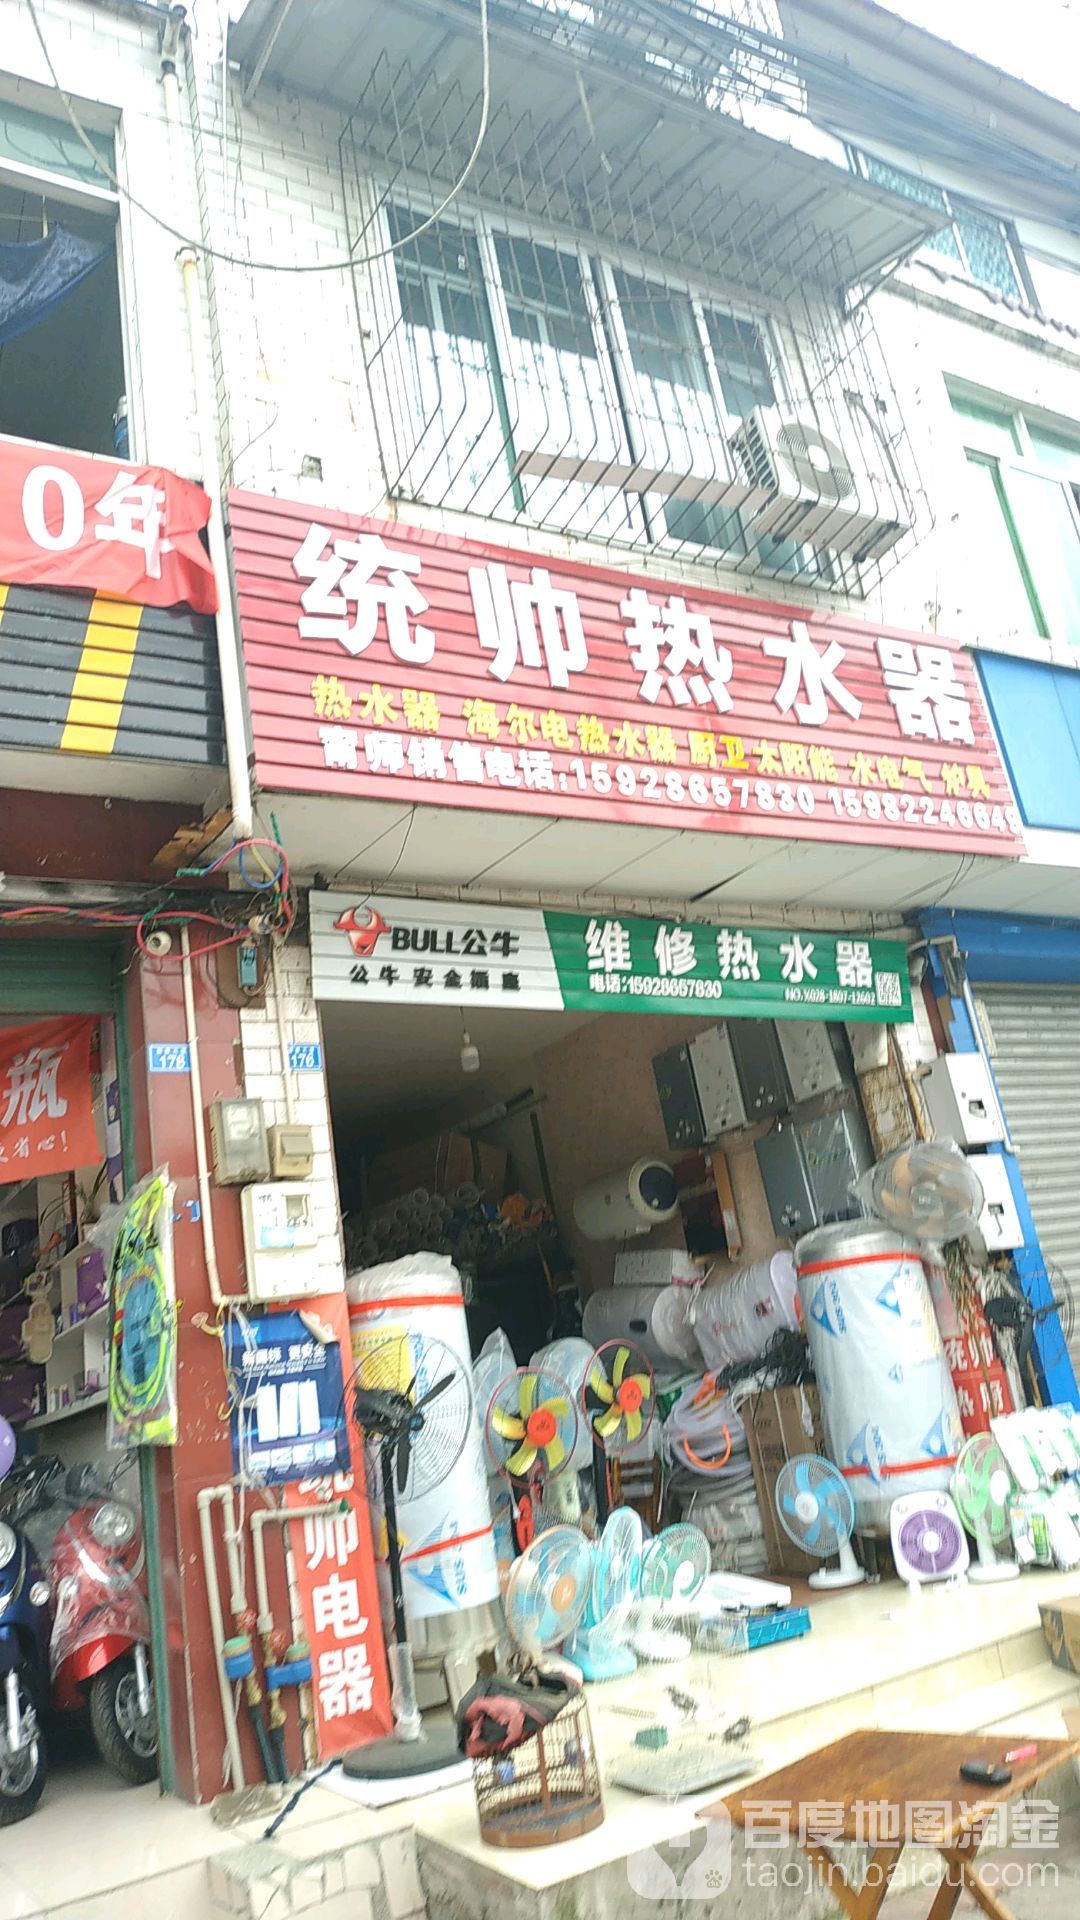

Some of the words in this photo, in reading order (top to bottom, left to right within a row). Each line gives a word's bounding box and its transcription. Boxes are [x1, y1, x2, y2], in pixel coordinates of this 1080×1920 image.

[292, 522, 975, 745] 统帅热水器
[311, 674, 441, 733] 热水器
[462, 697, 677, 765] 海尔电热水器
[688, 730, 750, 770] 厨卫
[753, 739, 838, 782] 太阳能
[848, 751, 933, 793] 水电气
[584, 918, 874, 989] 维修热水器
